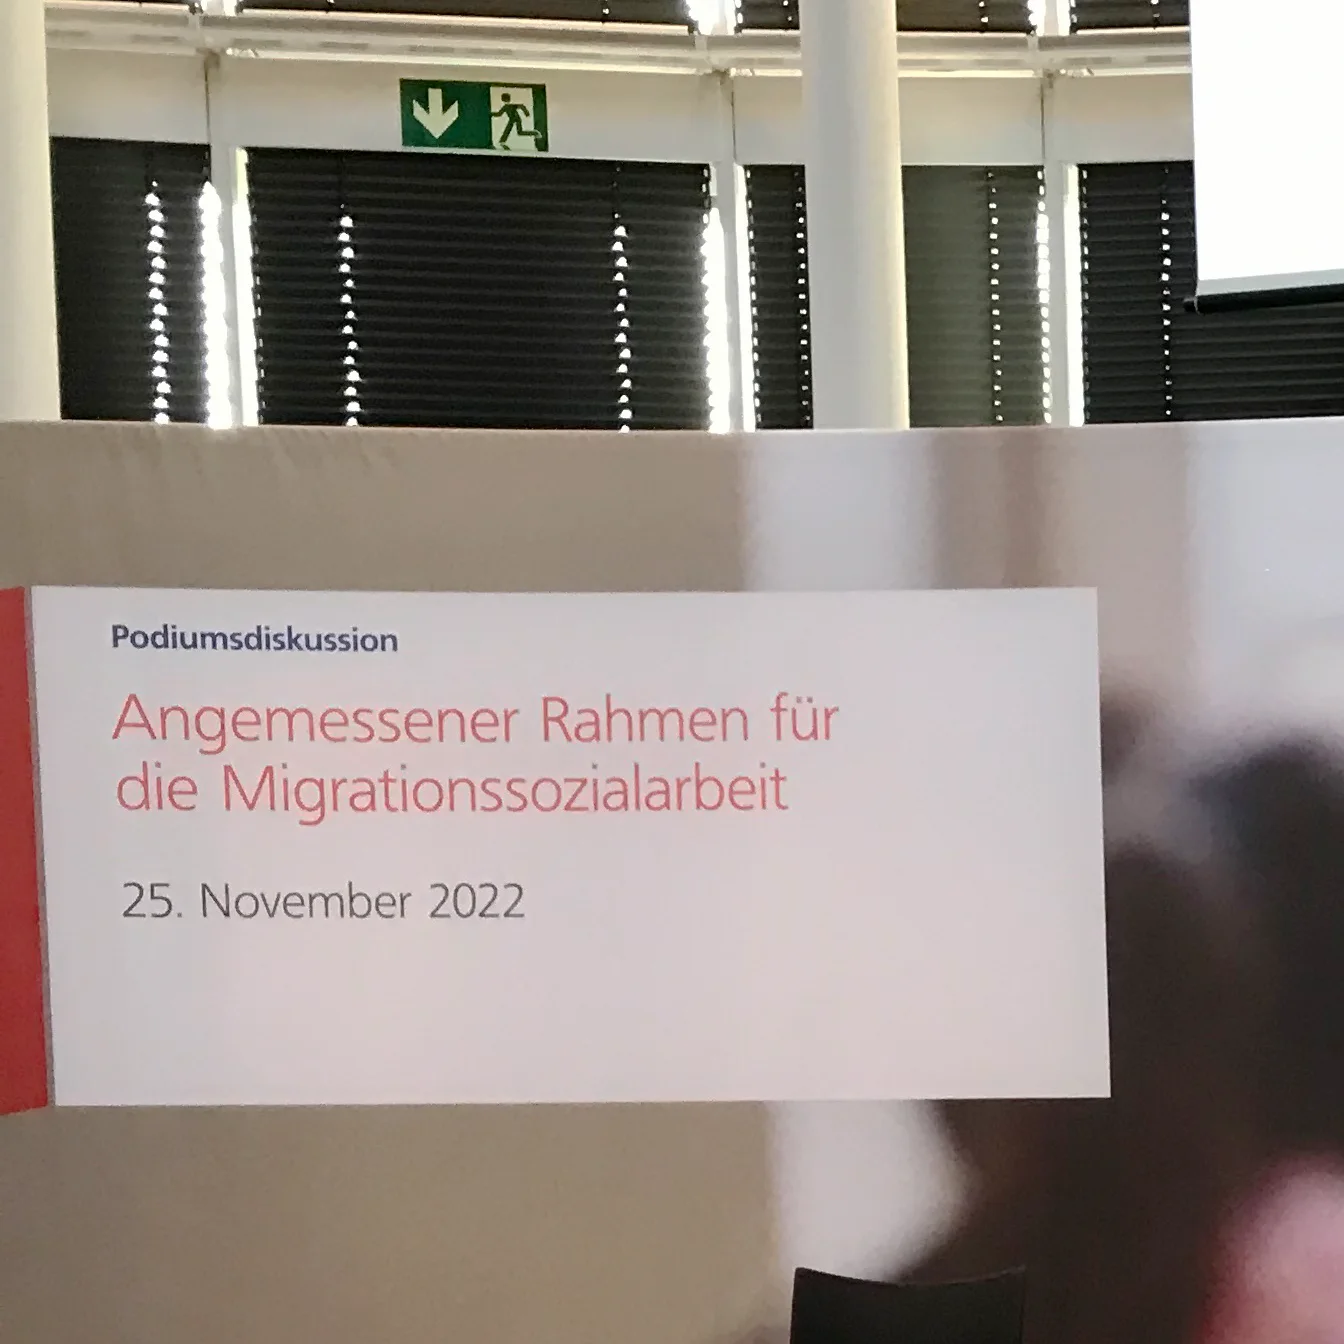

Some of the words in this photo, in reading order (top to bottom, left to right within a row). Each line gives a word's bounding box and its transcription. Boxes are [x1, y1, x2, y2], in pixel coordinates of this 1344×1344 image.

[111, 623, 399, 653] Podiumsdiskussion
[111, 693, 520, 752] Angemessener
[542, 693, 749, 743] Rahmen
[769, 691, 840, 742] für
[117, 760, 198, 812] die
[222, 761, 790, 826] Migrationssozialarbeit
[121, 881, 184, 920] 25.
[200, 881, 412, 920] November
[429, 882, 526, 920] 2022
